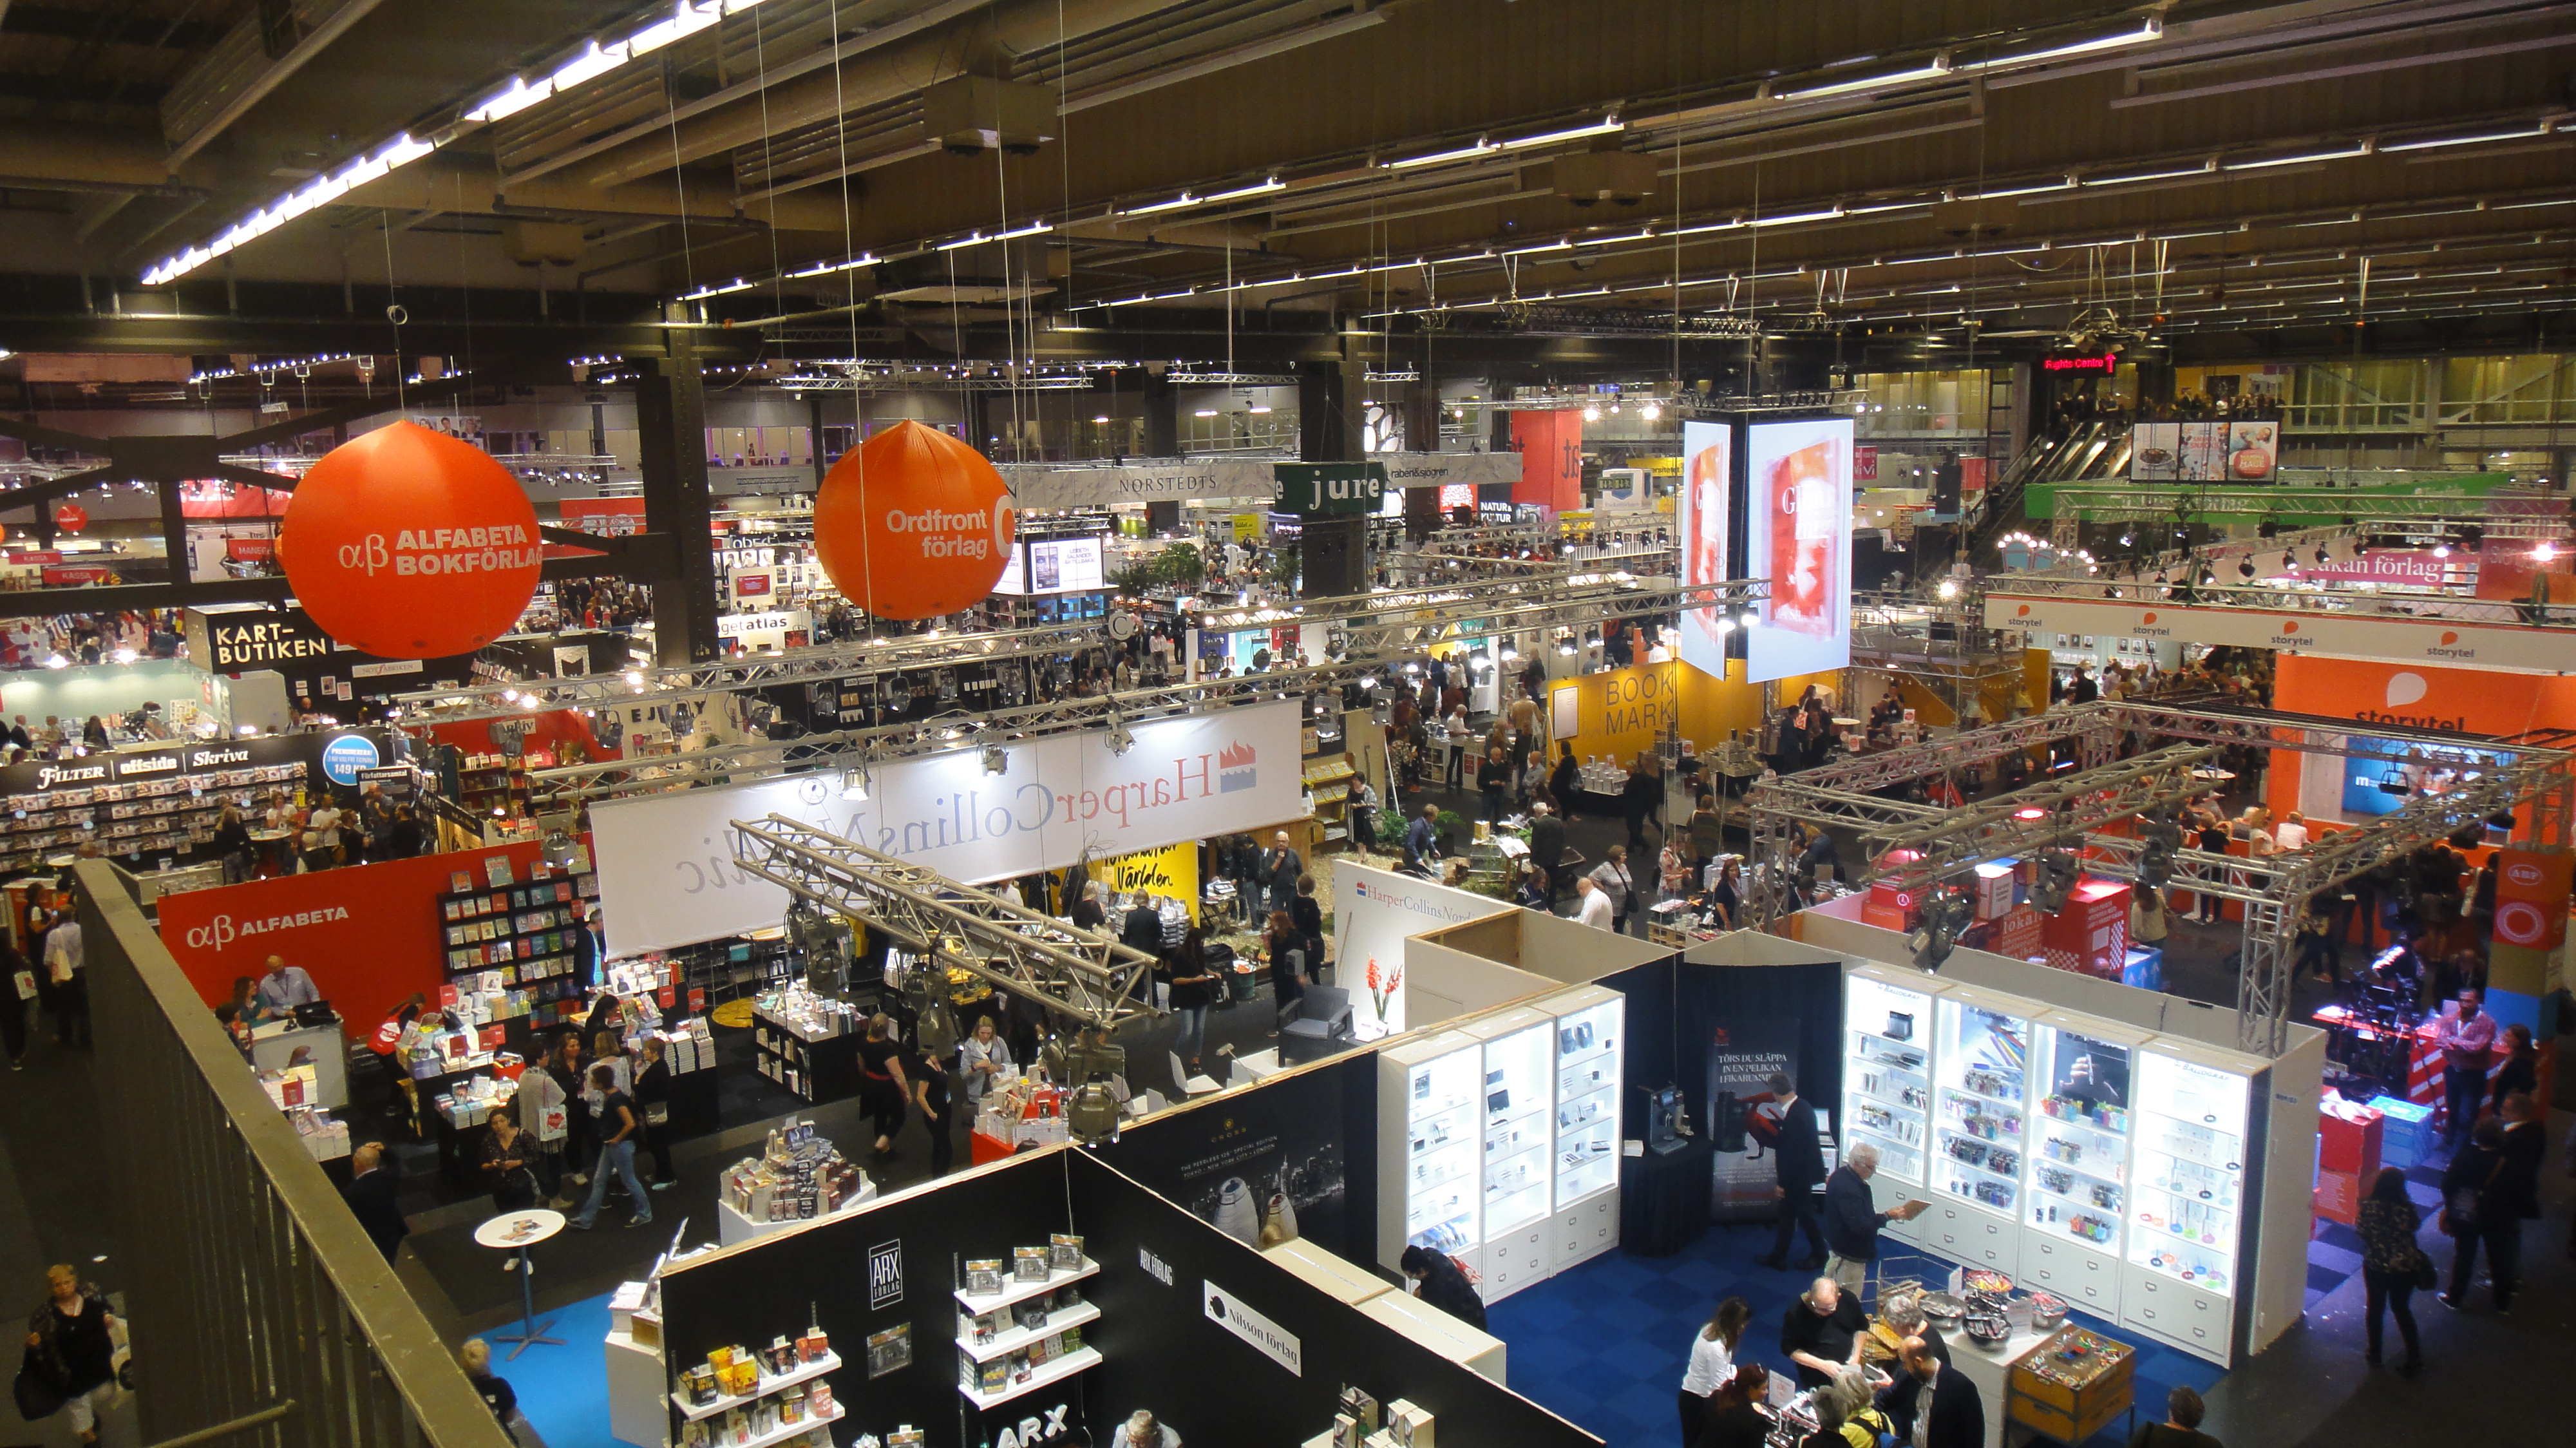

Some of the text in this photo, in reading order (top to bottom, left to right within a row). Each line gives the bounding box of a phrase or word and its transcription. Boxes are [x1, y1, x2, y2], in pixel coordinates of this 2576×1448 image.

[2075, 358, 2104, 368] Centre
[1119, 475, 1217, 493] NORSTEDTS
[1309, 470, 1380, 511] jure
[886, 509, 987, 533] Ordfront
[1481, 512, 1511, 523] KUTUR
[395, 524, 527, 550] ALFABETA
[922, 535, 987, 560] förlag
[2374, 555, 2441, 583] förlag
[2007, 618, 2042, 628] storytel
[2133, 626, 2172, 636] storytel
[218, 638, 327, 665] BUTIKEN
[2271, 635, 2313, 647] storytel
[2426, 647, 2476, 658] storytel
[1605, 670, 1674, 707] BOOK
[1605, 700, 1674, 736] MARK
[120, 756, 178, 774] offside
[192, 748, 249, 768] Skriva
[334, 764, 352, 774] 149
[37, 765, 106, 790] FILTER
[1117, 863, 1174, 891] Världen
[240, 907, 349, 936] ALFABETA
[1742, 1054, 1754, 1063] DU
[1755, 1053, 1787, 1062] SLÄPPA
[1234, 1143, 1255, 1154] SPECIAL
[1256, 1135, 1278, 1147] EDITION
[1183, 1168, 1202, 1178] TOKYO
[1220, 1156, 1235, 1165] YORK
[873, 1250, 900, 1288] ARX
[1140, 1248, 1173, 1286] ARX FÖRLAG
[874, 1281, 900, 1299] FÖRLAG
[1229, 1308, 1298, 1366] Nilsson förlag
[996, 1404, 1068, 1448] ARX
